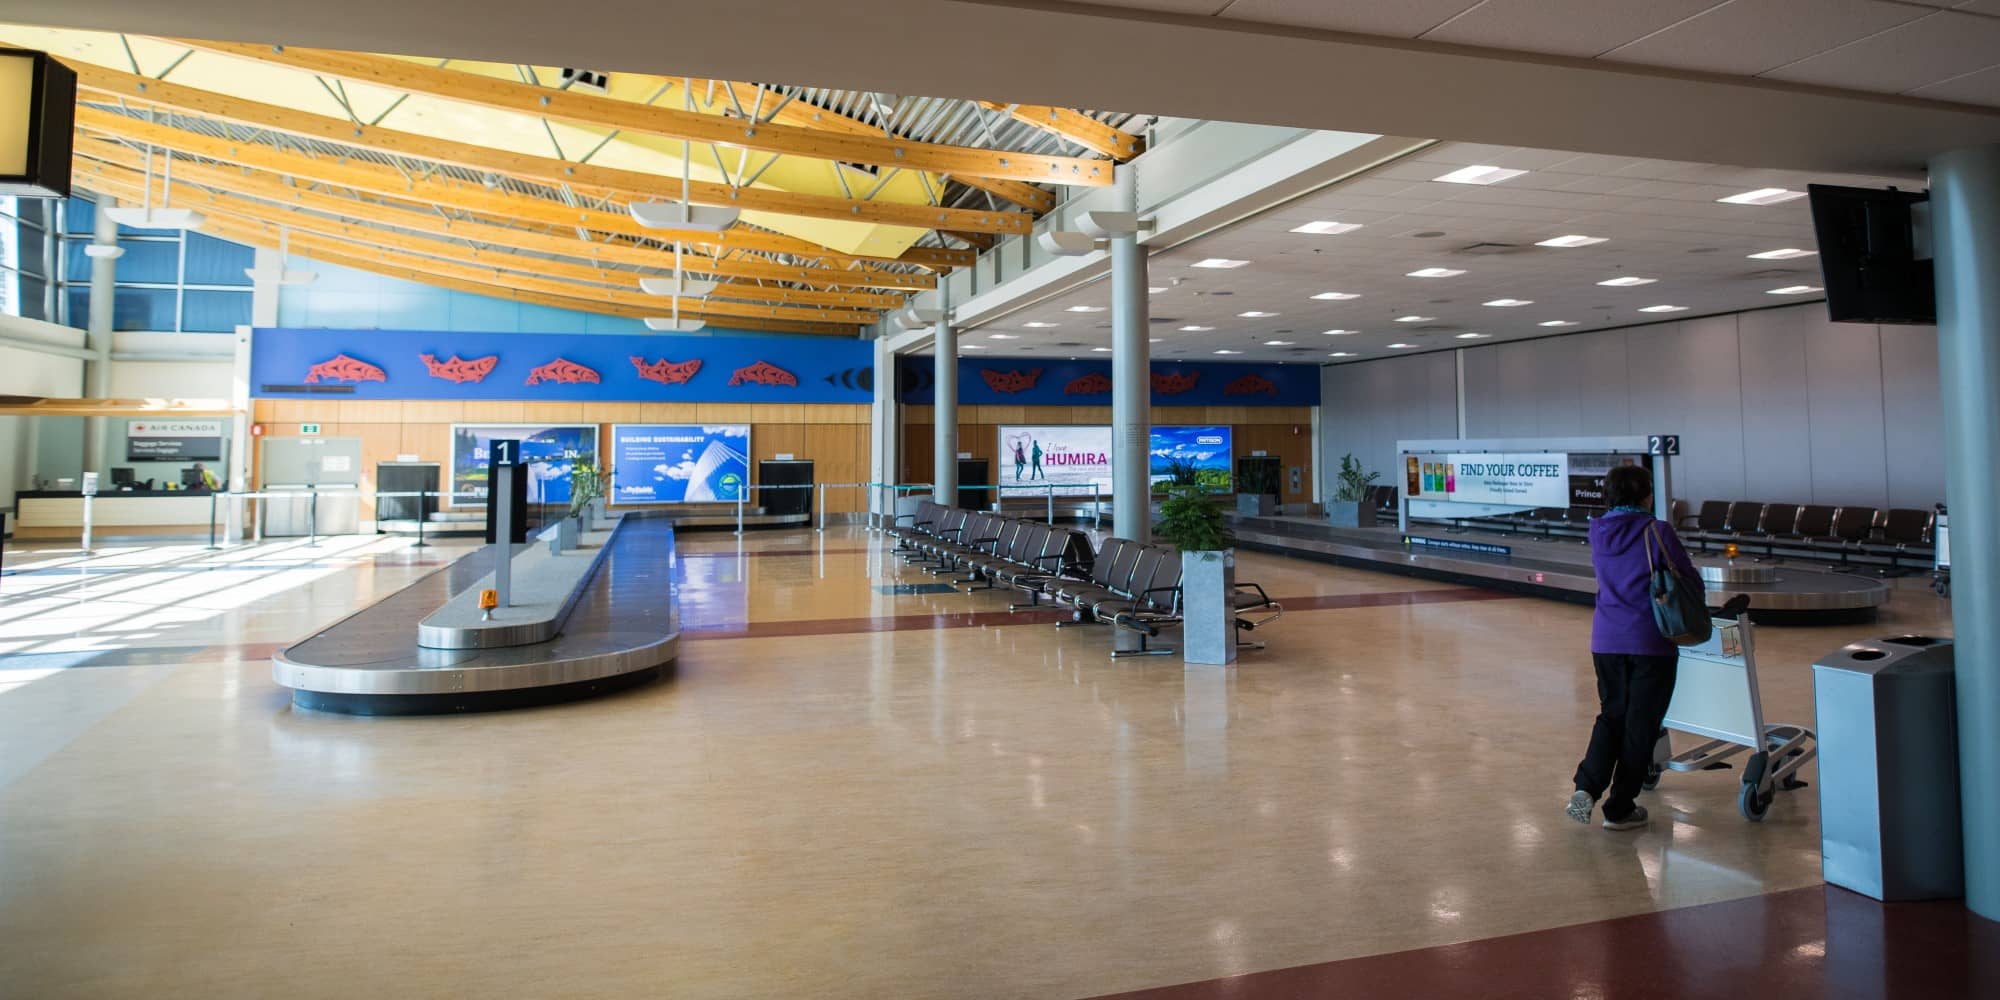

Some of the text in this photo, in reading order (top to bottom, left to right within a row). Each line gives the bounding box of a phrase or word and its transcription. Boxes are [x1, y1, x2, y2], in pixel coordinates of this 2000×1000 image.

[497, 442, 511, 465] 1
[1651, 437, 1660, 455] 2
[1667, 437, 1676, 454] 2
[1046, 453, 1107, 465] HUMIRA
[1460, 463, 1560, 478] FIND YOUR COFFEE
[1575, 489, 1602, 498] Prince
